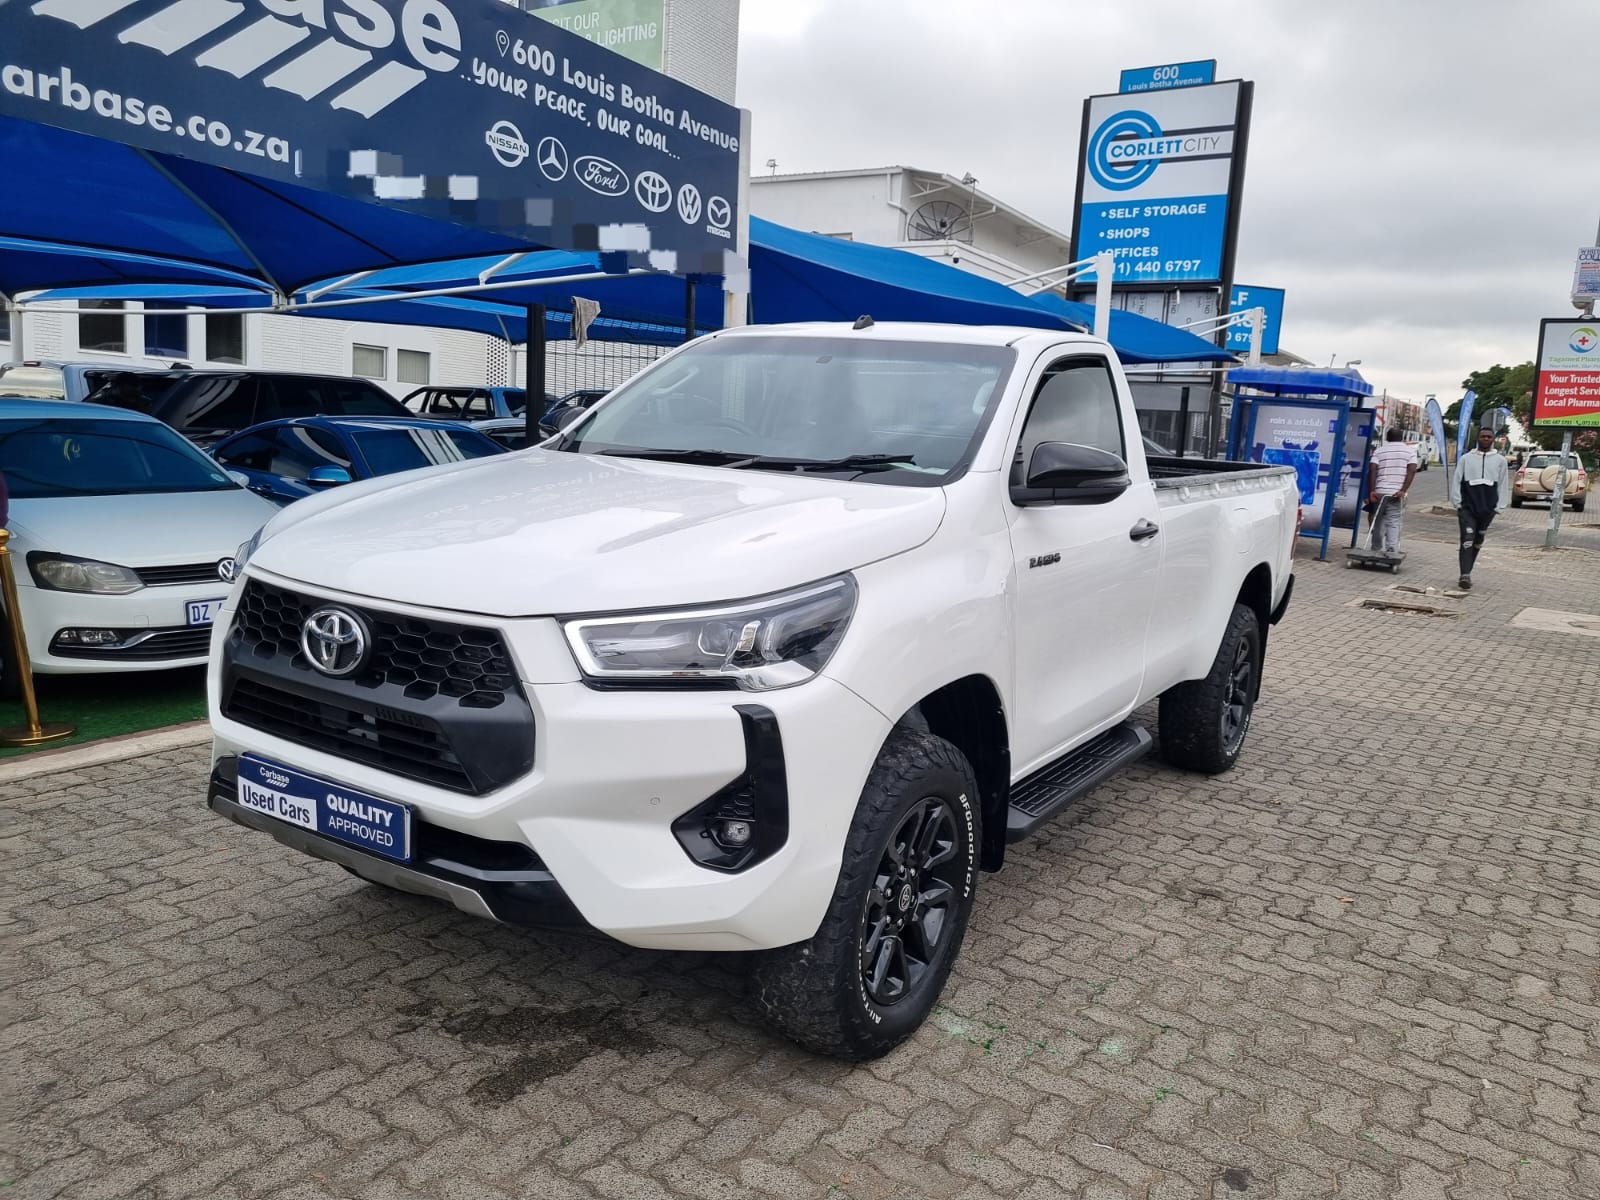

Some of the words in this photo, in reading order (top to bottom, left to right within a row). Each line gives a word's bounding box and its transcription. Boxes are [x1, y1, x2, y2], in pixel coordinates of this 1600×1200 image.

[574, 12, 600, 31] OUR
[1153, 65, 1179, 81] 600
[1127, 82, 1148, 91] Louis
[1149, 79, 1172, 89] Botha
[1173, 77, 1204, 88] Avenue
[512, 38, 555, 76] 600
[563, 57, 615, 102] Louis
[621, 83, 675, 126] Botha
[679, 110, 740, 153] Avenue
[597, 108, 631, 138] OUR
[487, 134, 527, 154] NISSAN
[584, 161, 620, 190] Ford
[1108, 207, 1140, 219] SELF
[1143, 203, 1207, 217] STORAGE
[1106, 227, 1150, 240] SHOPS
[1134, 261, 1161, 273] 440
[1165, 259, 1201, 273] 6797
[1550, 374, 1568, 384] Your
[1545, 385, 1578, 397] Longest
[1543, 397, 1566, 407] Local
[191, 604, 210, 622] DZ
[259, 766, 290, 784] Carbase
[242, 783, 275, 812] Used
[279, 796, 310, 824] Cars
[326, 793, 393, 827] QUALITY
[328, 815, 394, 847] APPROVED
